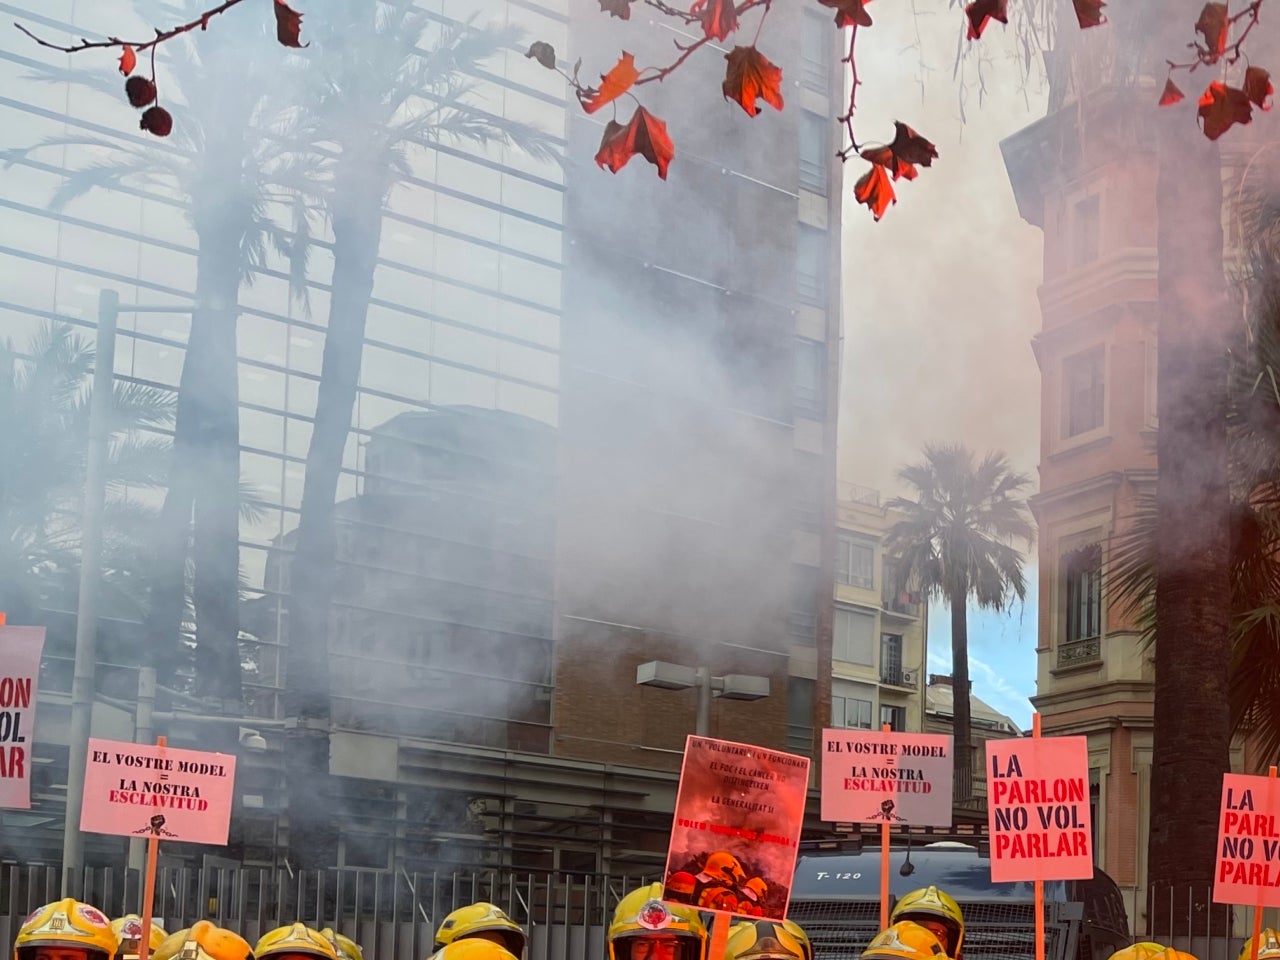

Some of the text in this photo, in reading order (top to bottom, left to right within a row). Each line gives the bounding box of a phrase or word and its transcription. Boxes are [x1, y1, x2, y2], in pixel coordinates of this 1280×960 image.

[827, 741, 946, 758] EL VOSTRE MODEL
[93, 751, 227, 777] EL VOSTRE MODEL
[709, 762, 718, 770] EL
[719, 763, 734, 773] FOC
[739, 767, 748, 776] EL
[768, 754, 808, 769] FUNCIONARI
[993, 754, 1022, 778] LA
[852, 766, 924, 780] LA NOSTRA
[120, 779, 200, 798] LA NOSTRA
[844, 778, 932, 794] ESCLAVITUD
[993, 778, 1084, 804] PARLON
[109, 790, 208, 812] ESCLAVITUD
[711, 796, 720, 804] LA
[721, 797, 767, 812] GENERALITAT
[1226, 788, 1254, 811] LA
[995, 805, 1084, 831] NO VOL
[996, 832, 1087, 859] PARLAR
[1222, 837, 1254, 860] NO
[835, 872, 862, 880] 120
